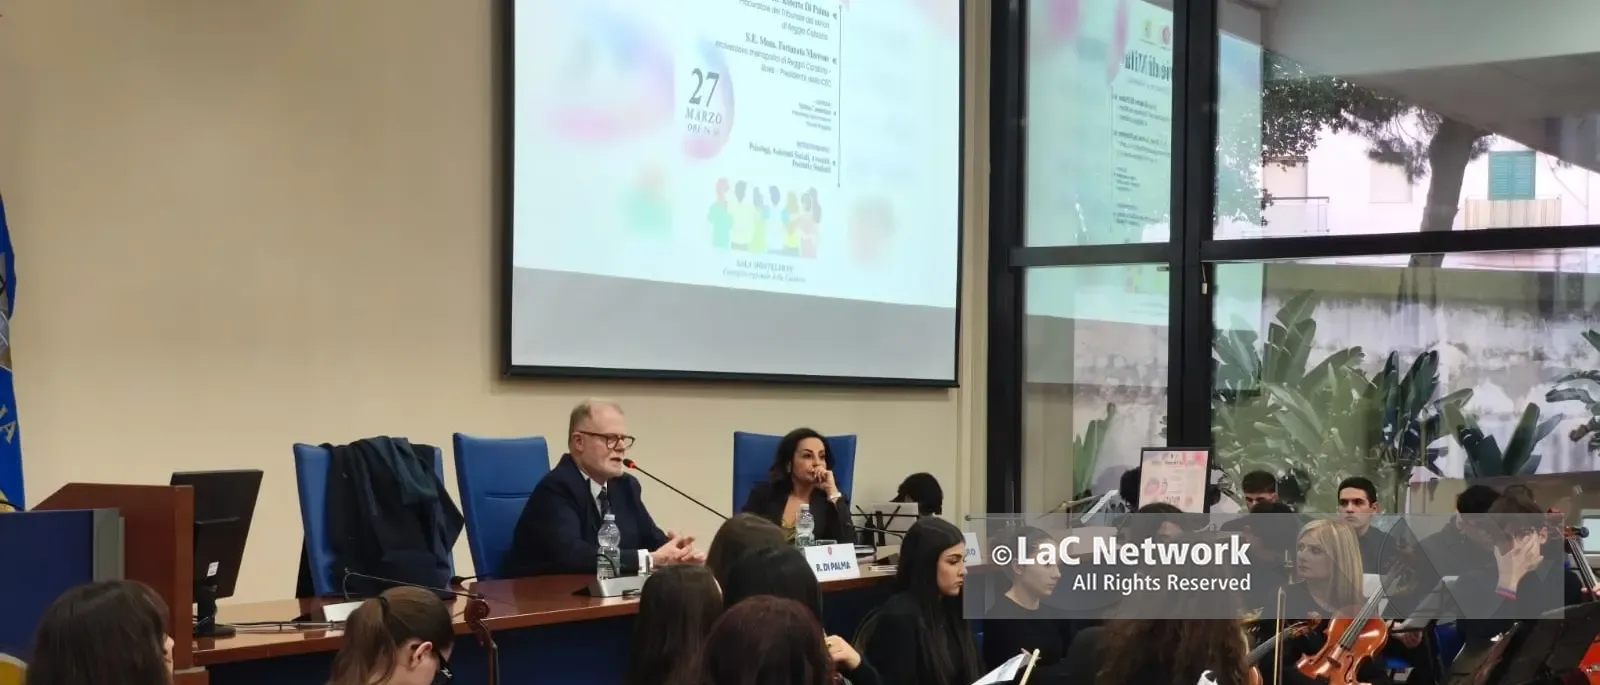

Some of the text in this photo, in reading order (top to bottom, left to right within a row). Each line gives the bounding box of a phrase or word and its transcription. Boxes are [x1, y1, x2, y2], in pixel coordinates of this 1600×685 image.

[688, 67, 720, 108] 27
[684, 107, 722, 125] MARZO
[816, 560, 851, 572] R. DI PALMA
